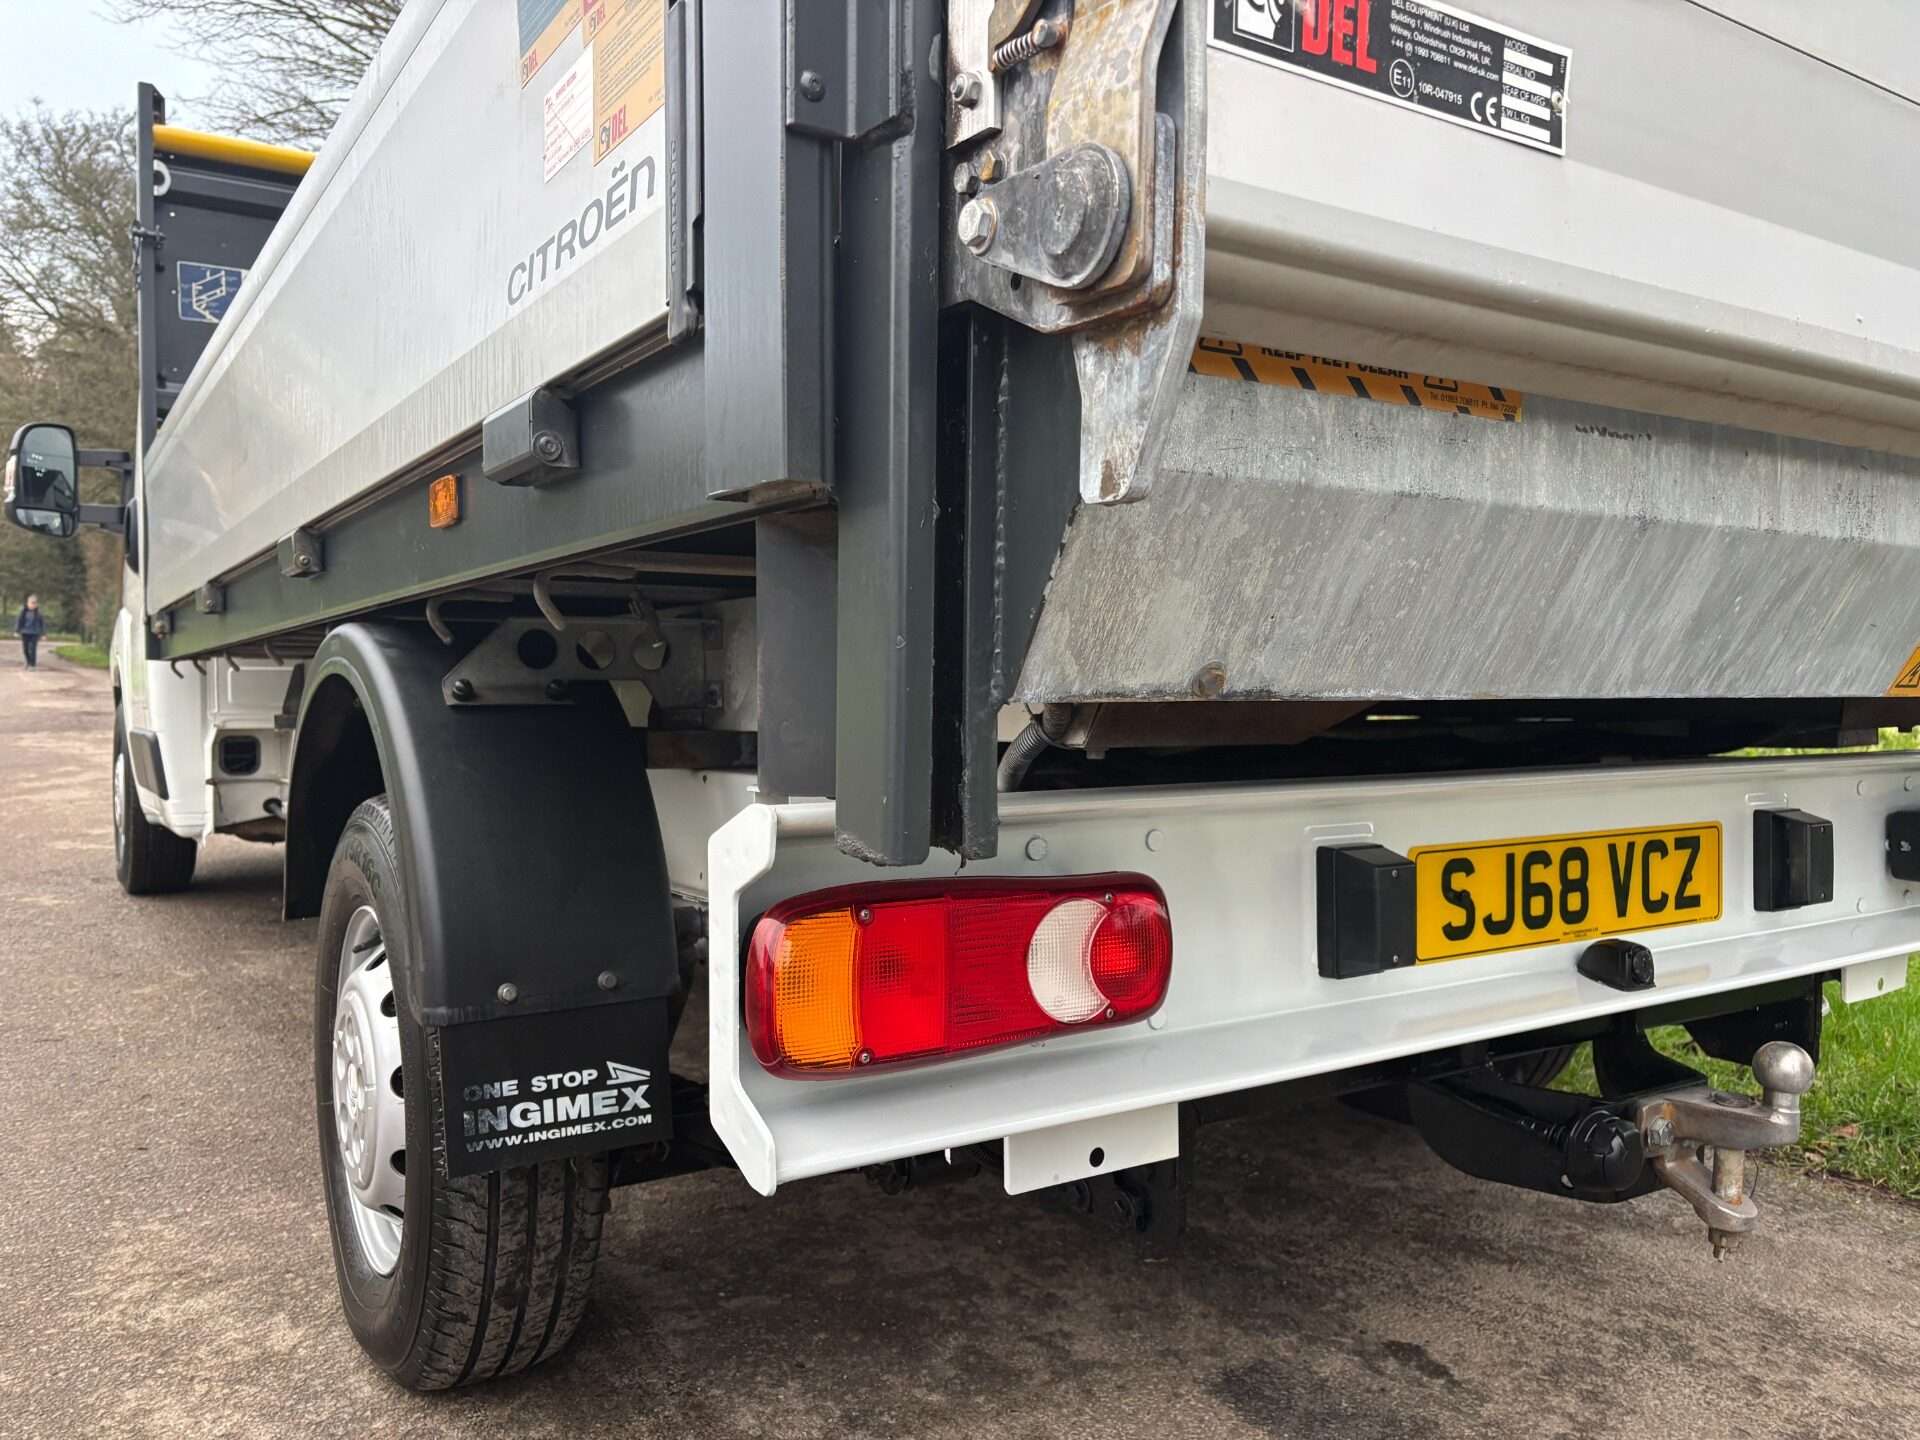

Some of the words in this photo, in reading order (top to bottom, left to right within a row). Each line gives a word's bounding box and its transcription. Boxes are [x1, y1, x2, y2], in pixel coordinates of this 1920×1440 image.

[1406, 2, 1444, 22] EQUIPMENT
[1302, 0, 1377, 74] DEL
[1391, 10, 1416, 29] Building
[1423, 22, 1451, 39] Windrush
[1452, 32, 1478, 49] Industrial
[1504, 38, 1528, 55] MODEL
[1453, 61, 1500, 81] www.del-uk.com
[1503, 61, 1523, 78] SERIAL
[1418, 81, 1463, 105] 10R-047915
[1502, 84, 1519, 98] YEAR
[612, 104, 628, 144] DEL
[1441, 846, 1589, 941] SJ68
[1607, 835, 1701, 918] VCZ
[463, 1079, 519, 1102] ONE
[531, 1069, 598, 1093] STOP
[463, 1085, 651, 1136] INGIMEX
[466, 1114, 653, 1152] WWW.INGIMEX.COM
